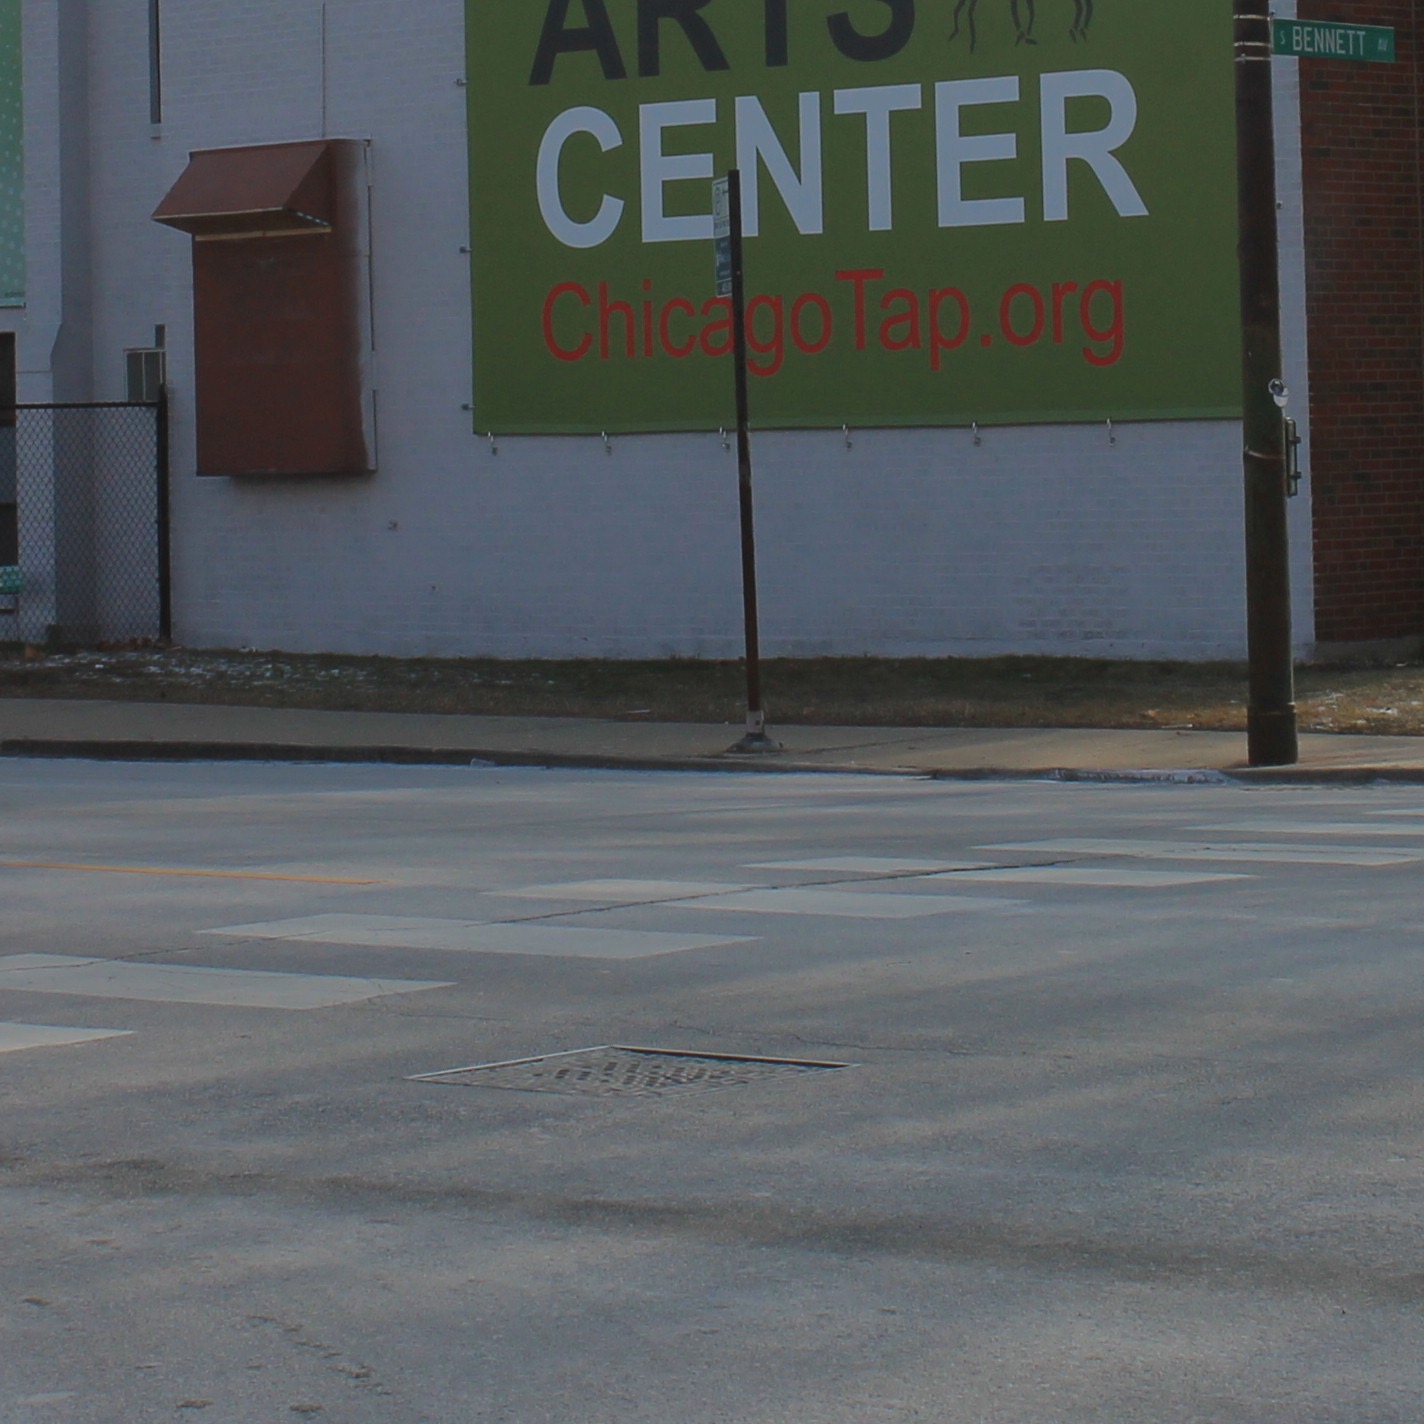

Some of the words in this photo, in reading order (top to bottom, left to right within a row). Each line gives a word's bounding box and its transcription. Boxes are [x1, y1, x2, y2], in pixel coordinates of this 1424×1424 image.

[1280, 30, 1286, 45] S
[1292, 26, 1366, 56] BENNETT
[535, 68, 1150, 249] CENTER
[541, 268, 1126, 377] ChicagoTap.org
